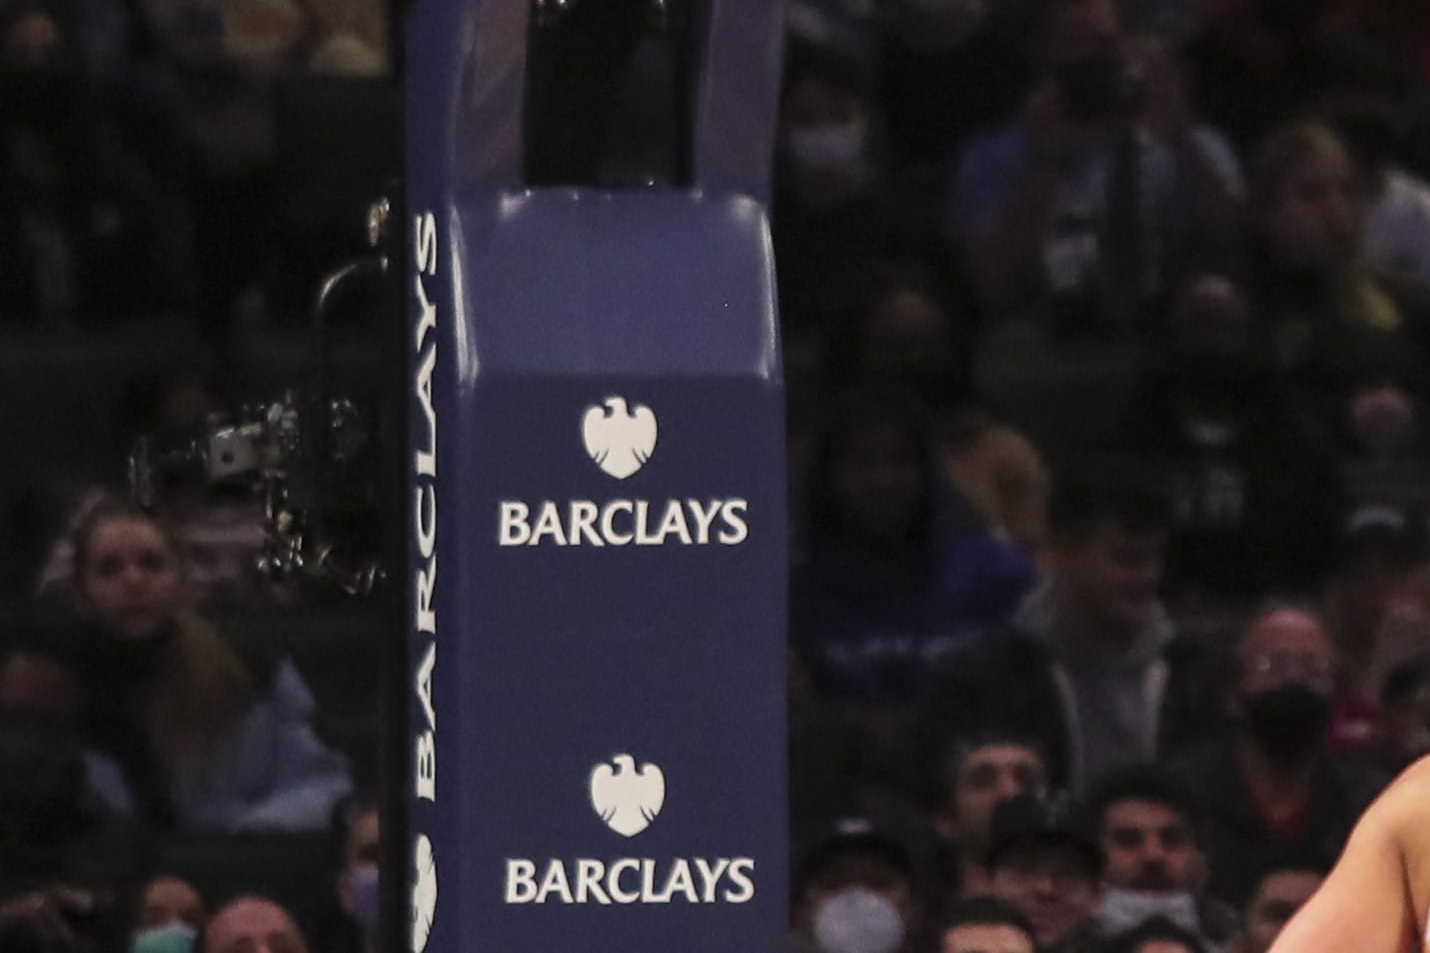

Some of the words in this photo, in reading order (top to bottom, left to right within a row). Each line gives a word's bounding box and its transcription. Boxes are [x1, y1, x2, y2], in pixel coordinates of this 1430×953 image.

[414, 209, 438, 803] BARCLAYS
[497, 499, 748, 547] BARCLAYS
[504, 857, 756, 906] BARCLAYS
